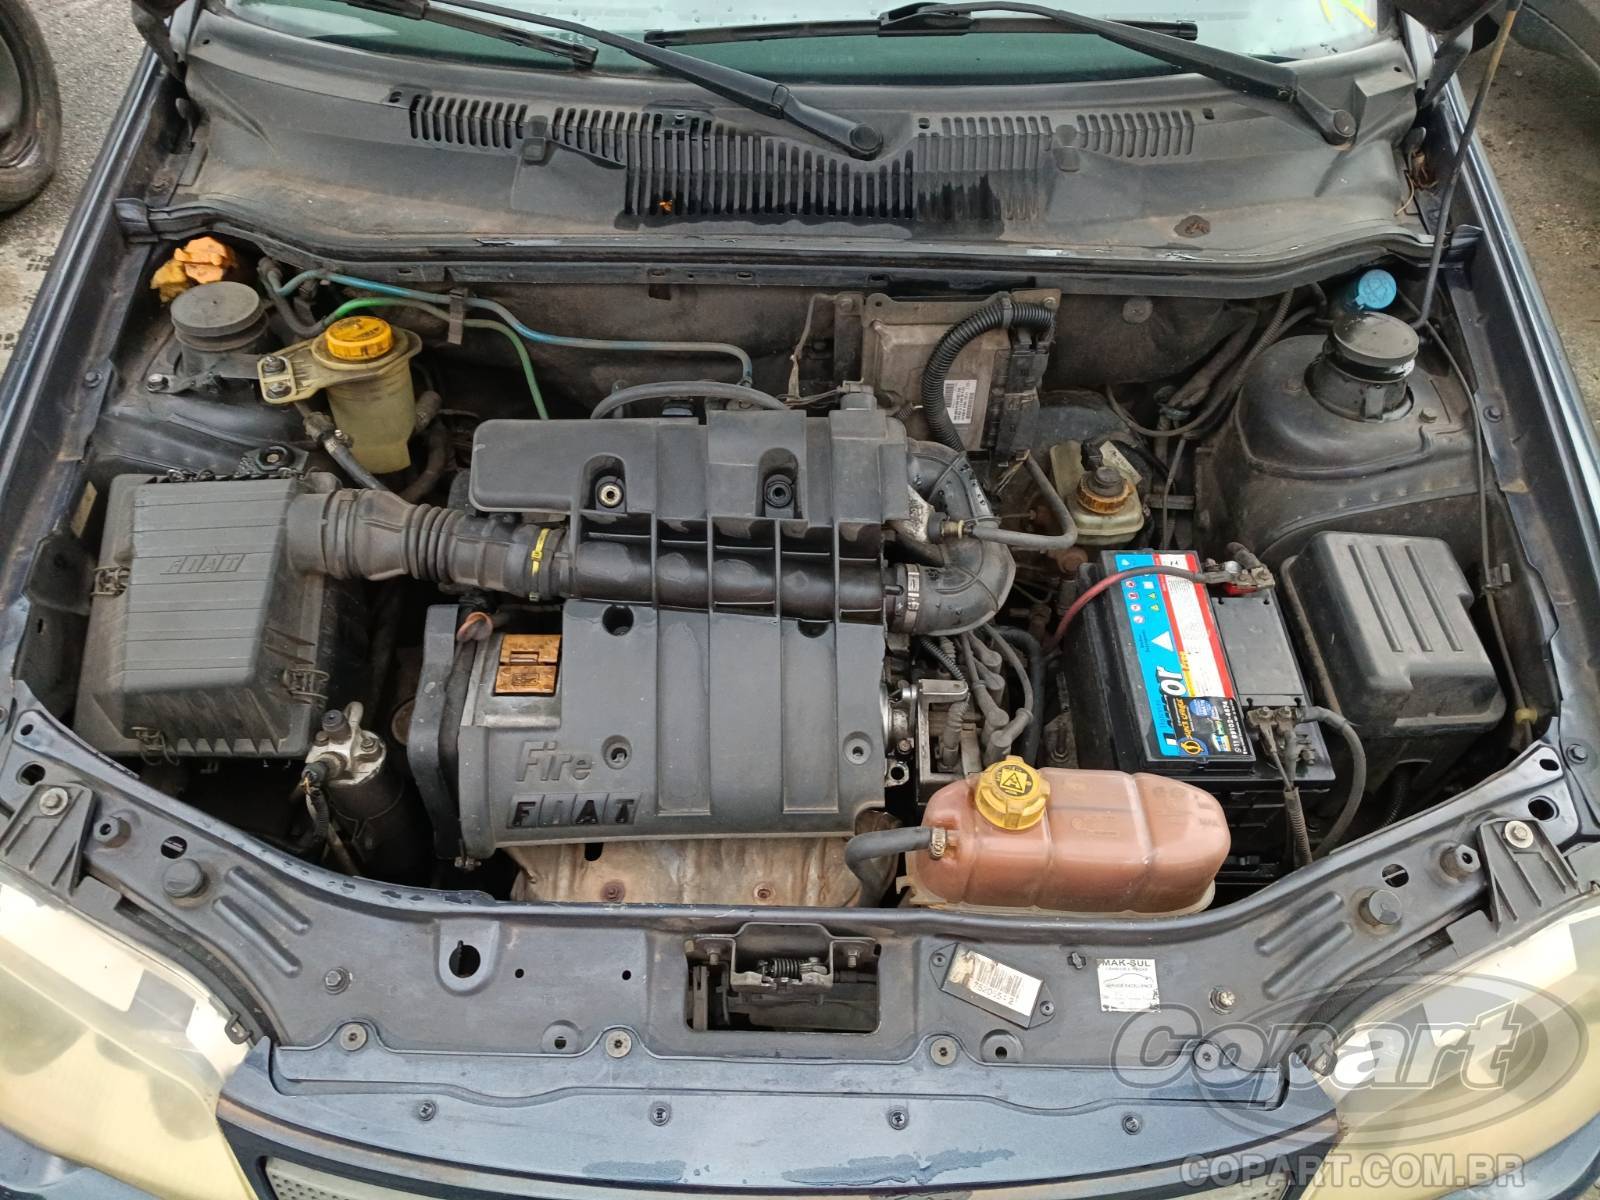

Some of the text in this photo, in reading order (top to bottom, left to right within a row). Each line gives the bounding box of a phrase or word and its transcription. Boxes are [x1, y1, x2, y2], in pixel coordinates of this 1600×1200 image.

[516, 740, 593, 782] Fire
[511, 798, 635, 828] FIAT
[1102, 959, 1152, 967] MAK-SUL
